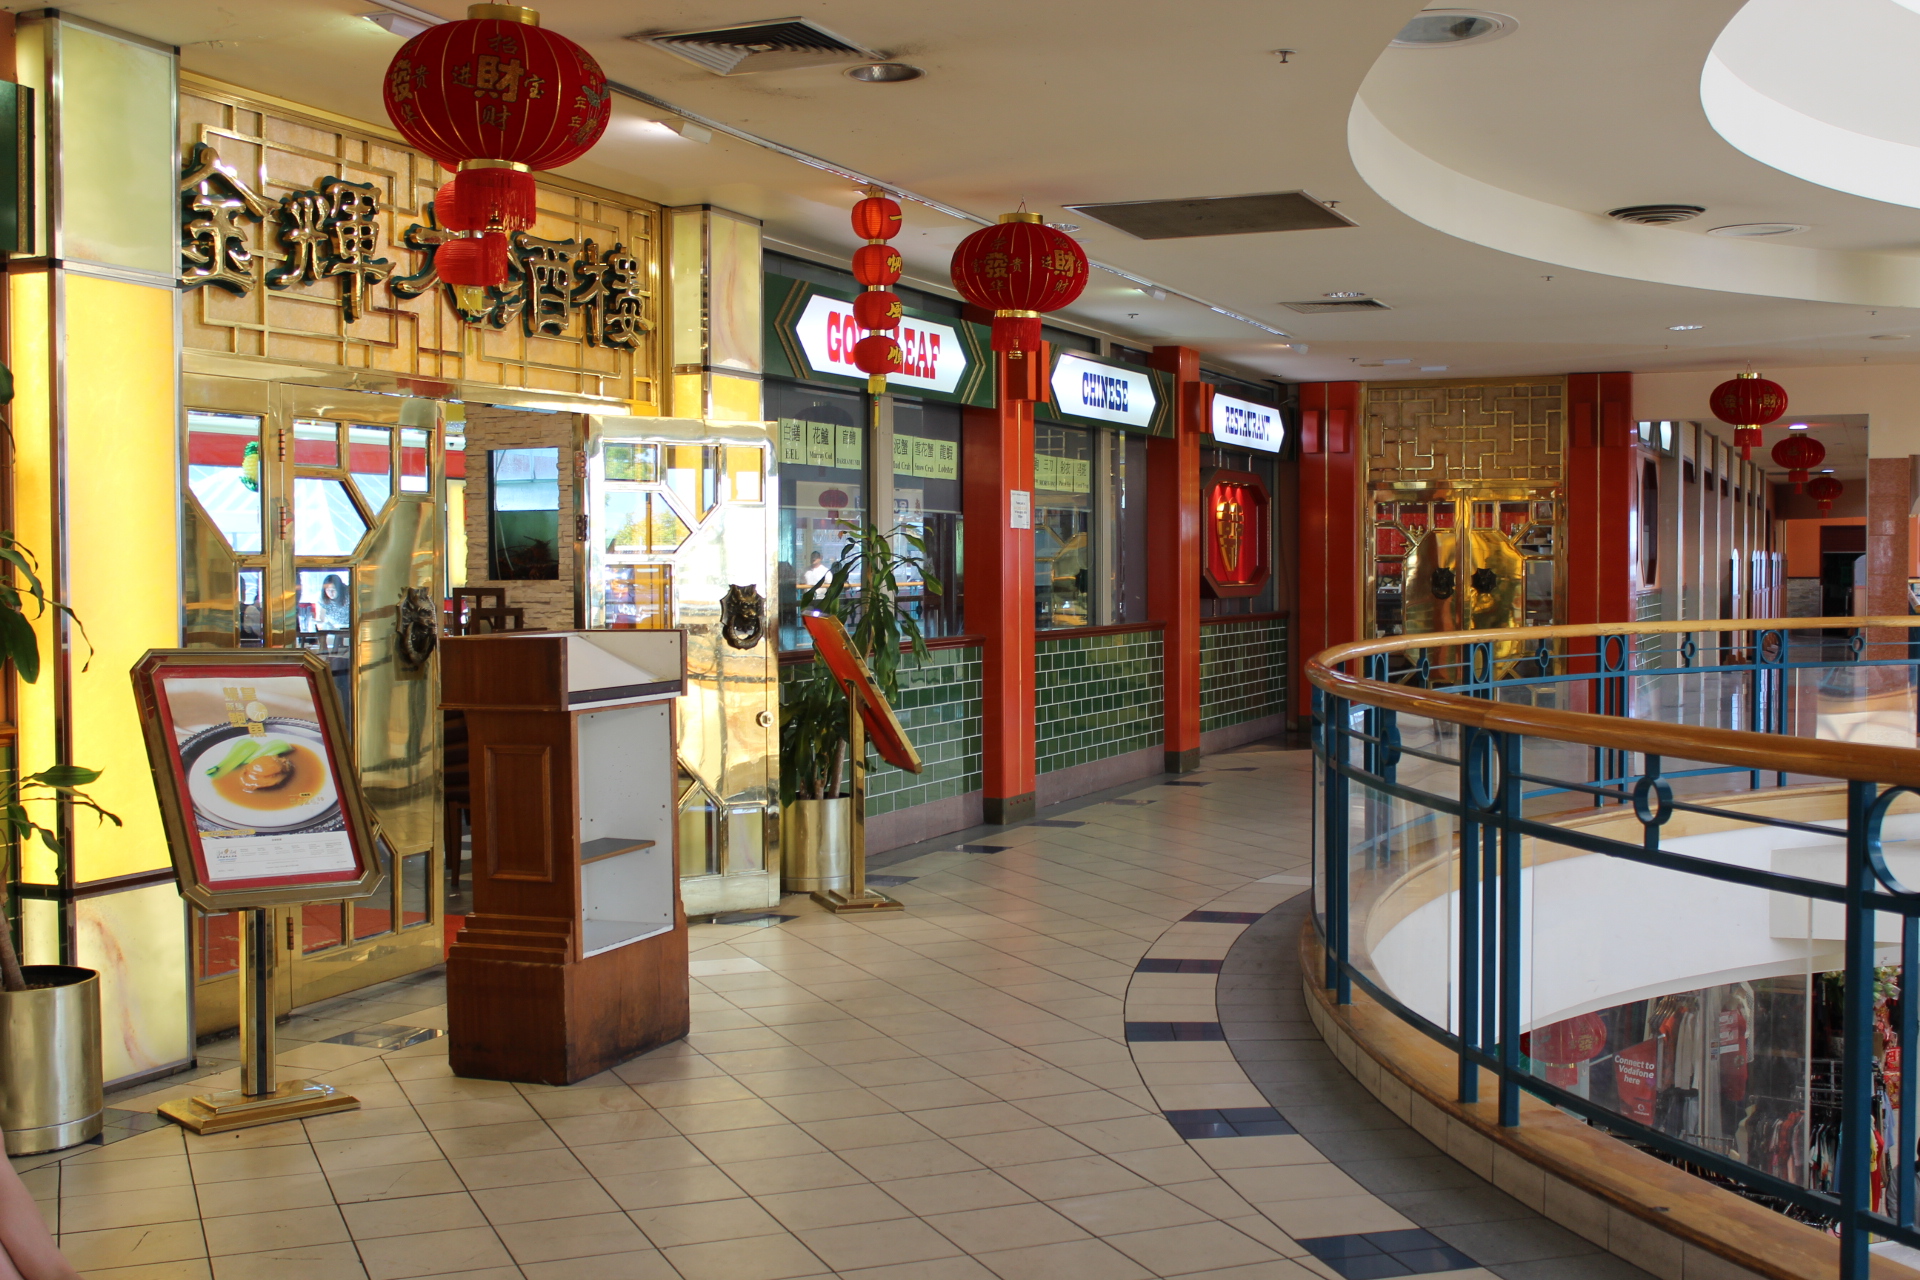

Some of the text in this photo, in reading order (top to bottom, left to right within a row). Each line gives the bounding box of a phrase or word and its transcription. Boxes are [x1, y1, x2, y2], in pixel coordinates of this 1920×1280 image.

[474, 54, 524, 102] 財
[1053, 249, 1076, 278] 財
[1082, 372, 1128, 412] CHINESE
[1225, 406, 1271, 441] RESTAURANT
[785, 448, 799, 460] EEL
[901, 461, 911, 471] Crab
[915, 463, 934, 473] Snow Crab
[938, 464, 953, 474] Lobster
[1614, 1055, 1655, 1070] Connect to
[1619, 1064, 1654, 1079] Vodafone
[1623, 1074, 1640, 1085] here
